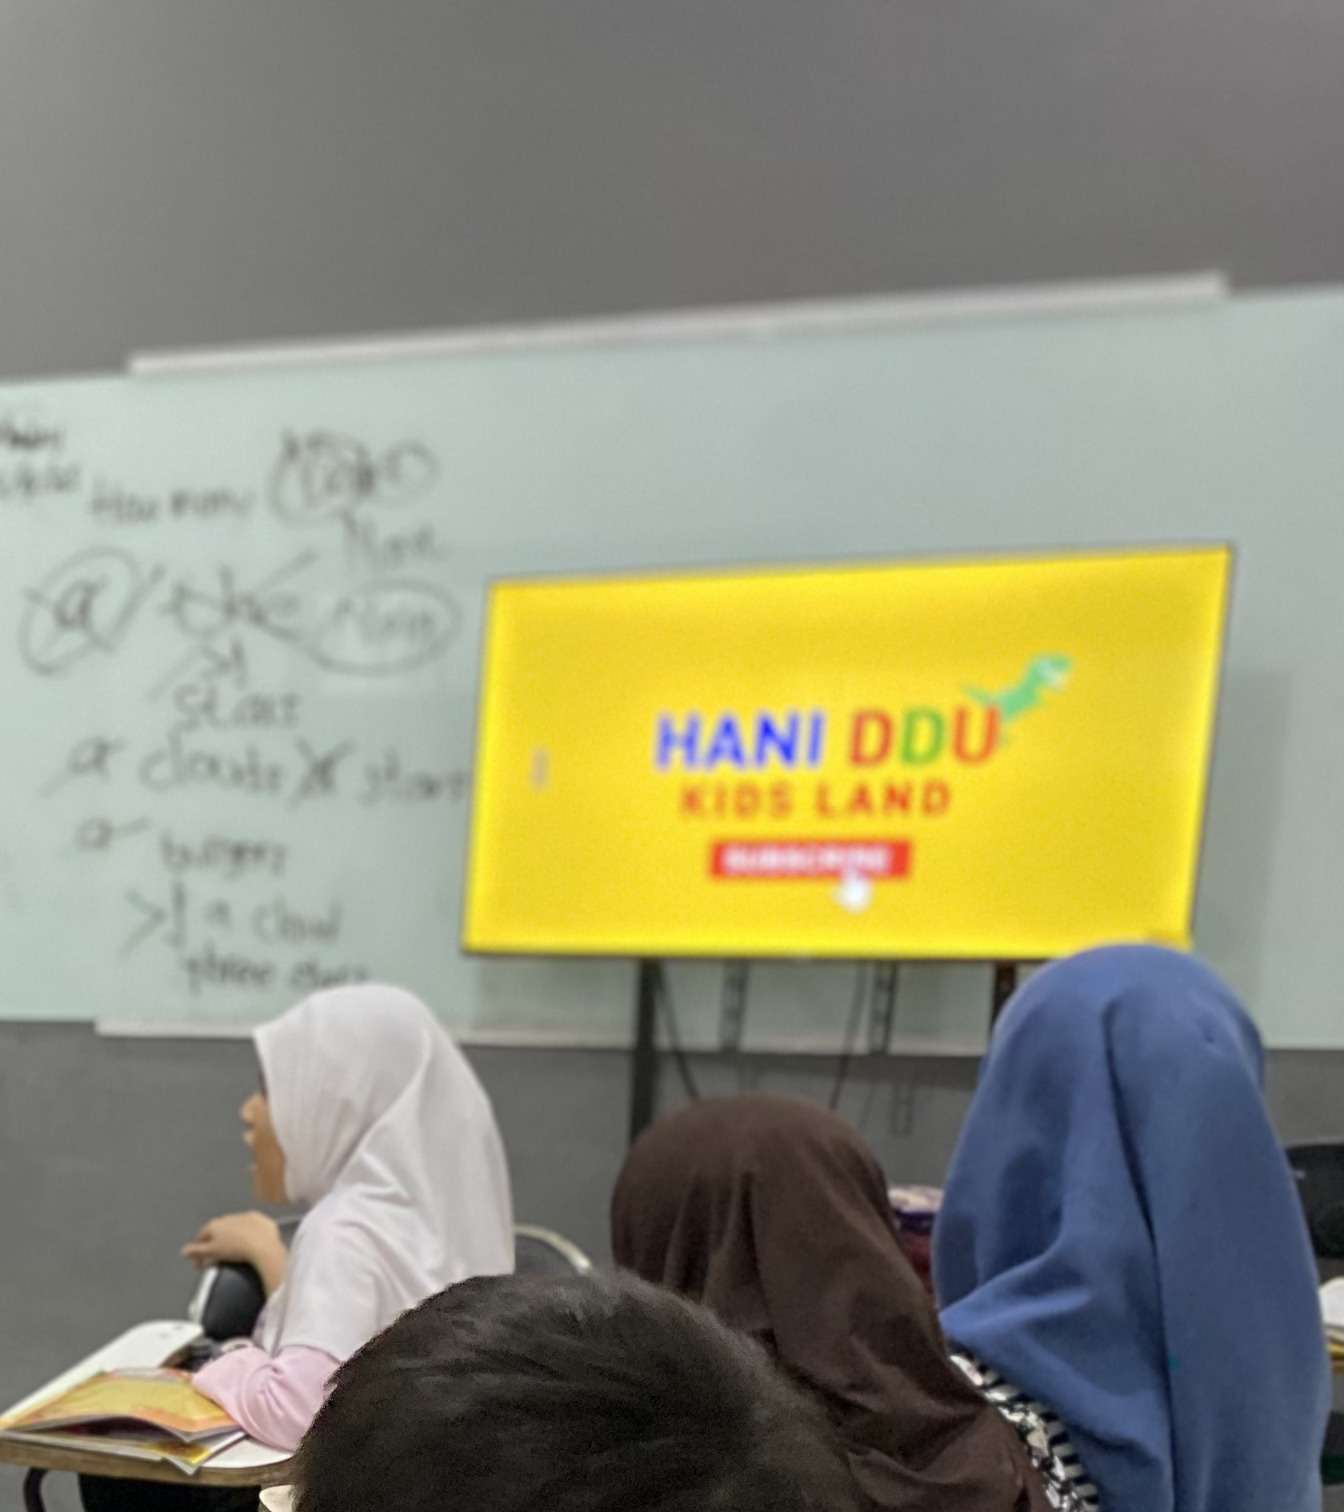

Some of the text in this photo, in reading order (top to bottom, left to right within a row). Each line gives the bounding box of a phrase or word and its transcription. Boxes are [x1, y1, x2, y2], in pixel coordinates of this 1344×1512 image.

[656, 704, 1003, 771] HANI DDU
[679, 778, 953, 818] KIDS LAND
